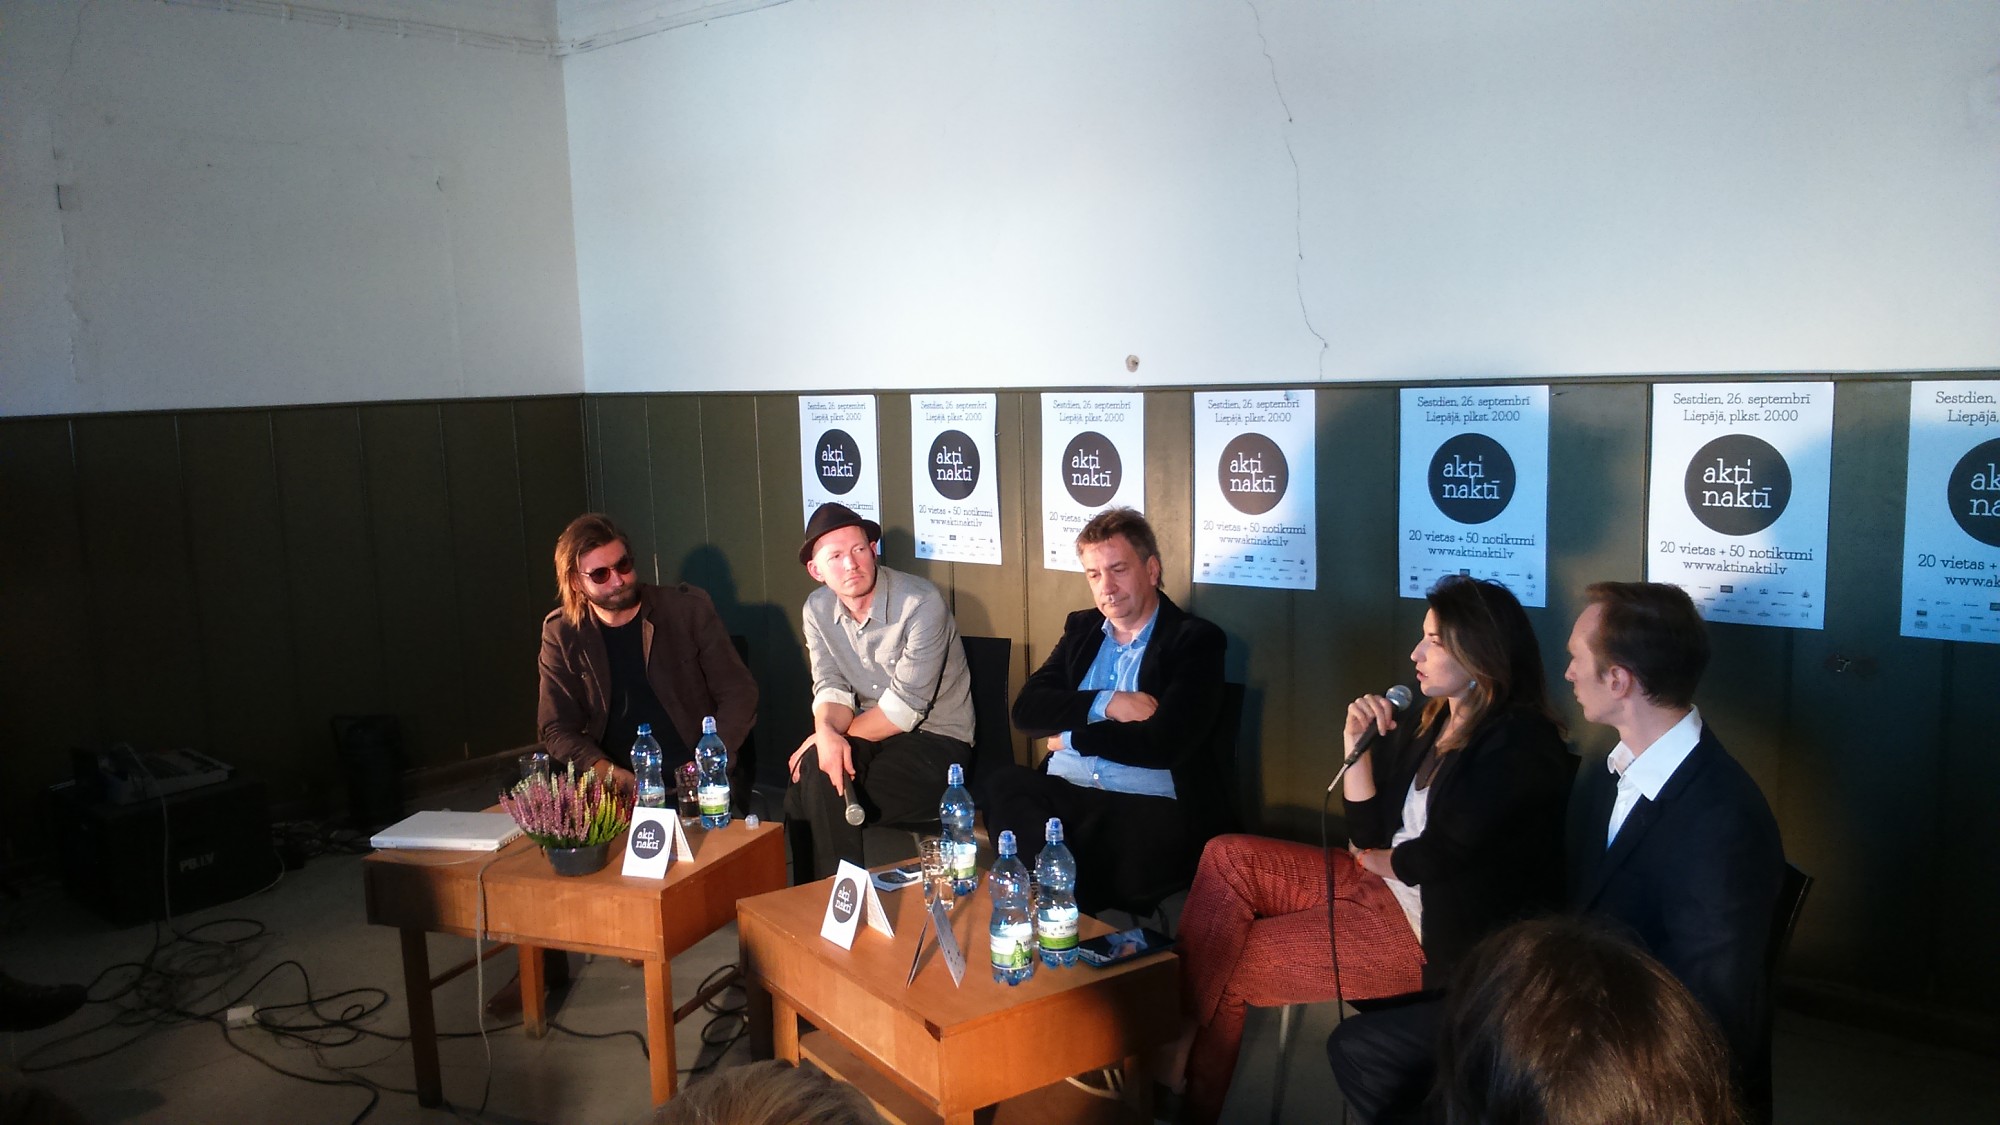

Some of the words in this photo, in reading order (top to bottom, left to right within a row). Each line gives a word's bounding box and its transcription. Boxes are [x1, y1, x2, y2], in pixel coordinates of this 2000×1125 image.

[1417, 396, 1459, 407] Sestdien,
[1461, 396, 1475, 407] 26.
[1478, 395, 1531, 409] septembrī
[1673, 393, 1724, 405] Sestdien,
[1727, 393, 1744, 405] 26.
[1747, 392, 1811, 408] septembrī
[1935, 391, 1997, 404] Sestdien,
[1491, 410, 1520, 422] 20:00
[1683, 409, 1727, 425] Liepājā,
[1729, 409, 1760, 425] plkst.
[1764, 409, 1799, 422] 20:00
[1947, 409, 1999, 426] Liepājā,
[821, 444, 844, 462] akti
[936, 446, 963, 465] akti
[1071, 448, 1100, 469] akti
[822, 460, 854, 477] naktī
[1229, 452, 1263, 474] akti
[1442, 454, 1485, 479] akti
[1702, 457, 1753, 485] akti
[936, 464, 972, 481] naktī
[1071, 467, 1112, 487] naktī
[1970, 463, 2000, 491] ak
[1229, 471, 1277, 493] naktī
[1442, 476, 1500, 500] naktī
[1702, 482, 1772, 509] naktī
[919, 505, 927, 514] 20
[928, 505, 946, 515] vietas
[953, 506, 962, 516] 50
[963, 507, 993, 518] notikumi
[1049, 511, 1059, 521] 20
[1060, 513, 1081, 523] vietas
[1203, 520, 1214, 531] 20
[1216, 521, 1241, 532] vietas
[1249, 522, 1260, 533] 50
[1262, 523, 1307, 535] notikumi
[1408, 529, 1422, 541] 20
[1424, 531, 1455, 543] vietas
[1465, 532, 1479, 543] 50
[1482, 533, 1536, 546] notikumi
[1660, 541, 1676, 553] 20
[1679, 542, 1716, 556] vietas
[1729, 545, 1745, 558] 50
[1748, 546, 1814, 561] notikumi
[1683, 560, 1788, 575] www.aktinakti.lv
[1918, 554, 1937, 568] 20
[1940, 555, 1985, 570] vietas
[1990, 562, 1998, 570] +
